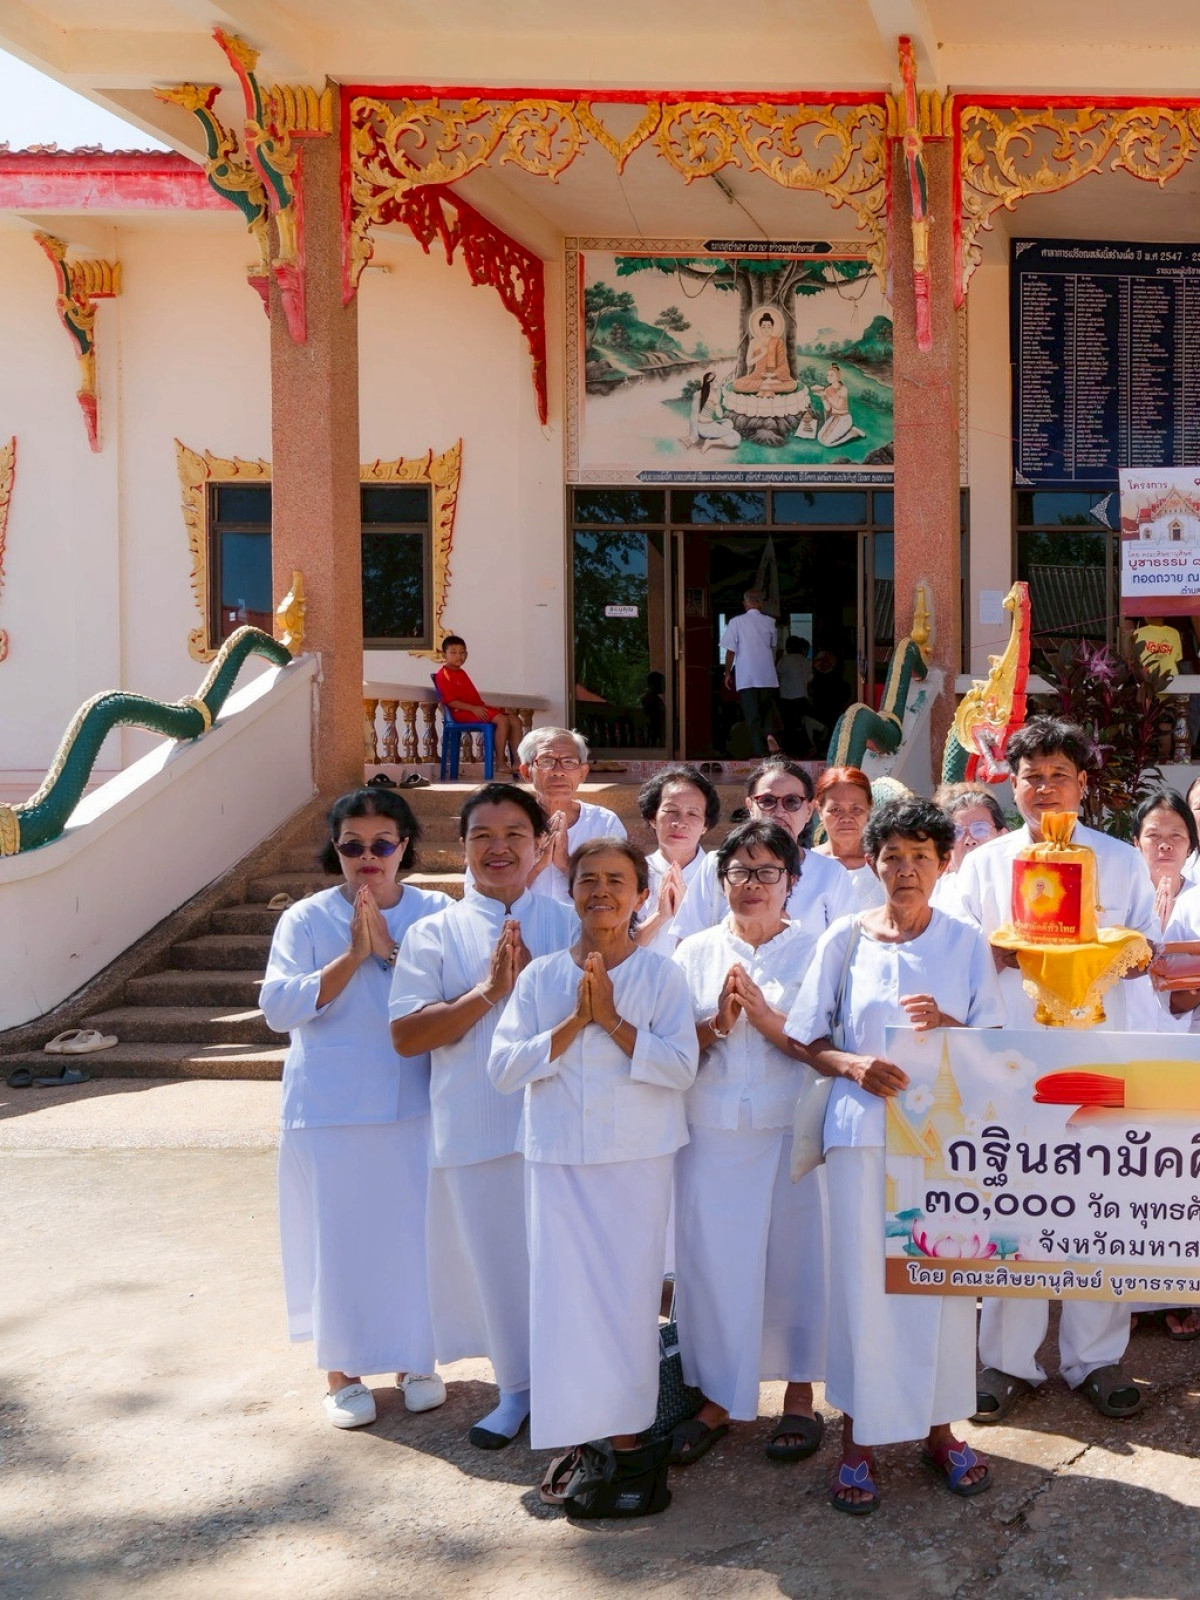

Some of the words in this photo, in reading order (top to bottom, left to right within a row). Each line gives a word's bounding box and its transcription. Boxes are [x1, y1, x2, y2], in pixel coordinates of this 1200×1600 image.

[1160, 251, 1182, 261] 2547
[1128, 479, 1168, 490] โครงการ
[1128, 557, 1187, 571] บูชาธรรม
[1132, 571, 1183, 584] ทอดถวาย
[1187, 572, 1200, 583] ณ
[925, 1190, 1076, 1220] ๓๐,๐๐๐
[1088, 1194, 1119, 1220] วัด
[908, 1264, 944, 1284] โดย
[952, 1268, 1103, 1293] คณะศิษยานุศิษย์
[1110, 1275, 1200, 1296] บูชาธรรม
